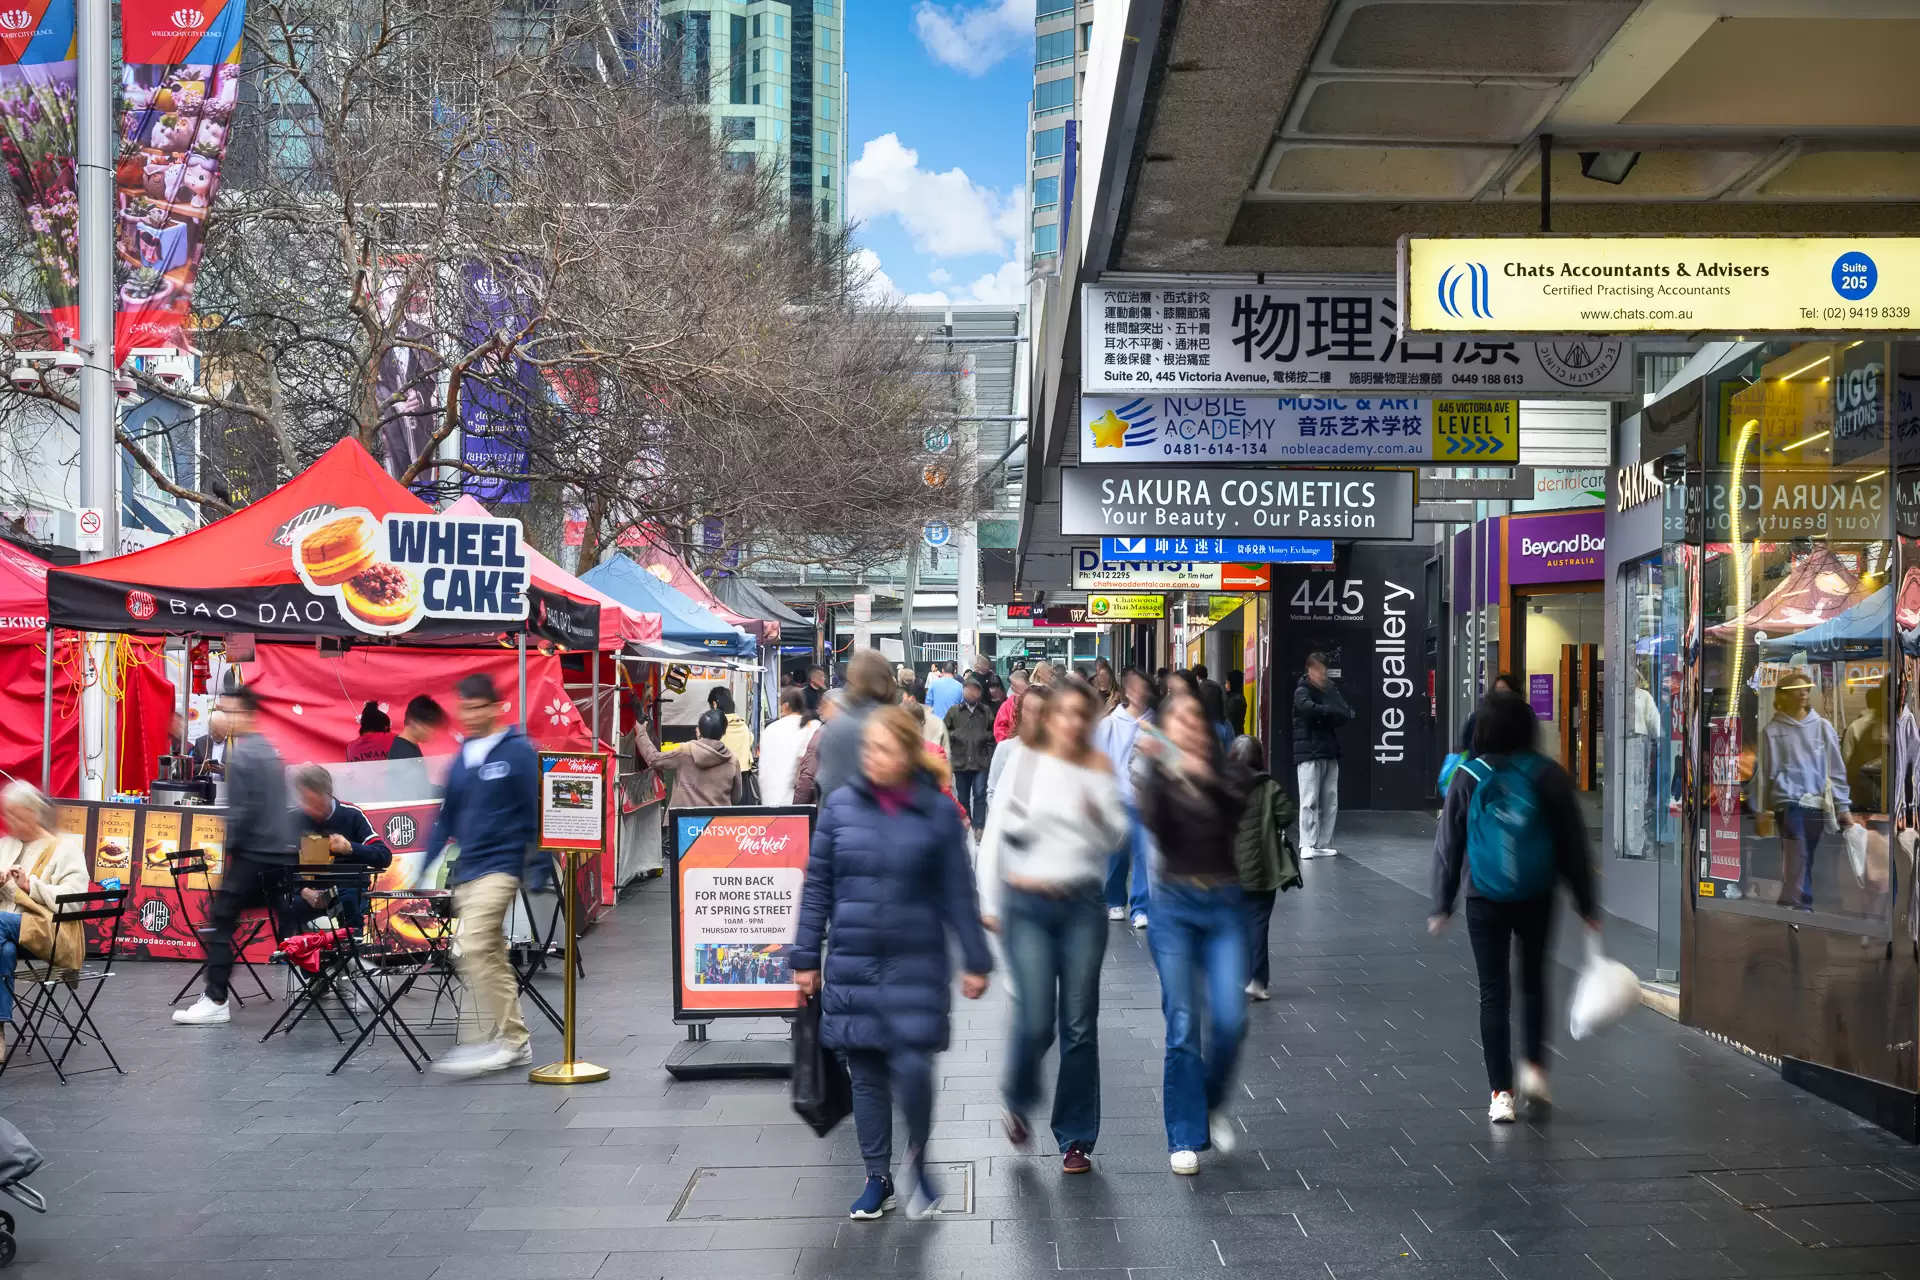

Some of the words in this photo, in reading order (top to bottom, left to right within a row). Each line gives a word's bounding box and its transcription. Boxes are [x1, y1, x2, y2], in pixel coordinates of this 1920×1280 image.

[1503, 262, 1555, 277] Chats
[1560, 262, 1670, 277] Accountants
[1676, 262, 1691, 277] &
[1696, 262, 1770, 277] Advisers
[1841, 262, 1868, 273] Suite
[1841, 276, 1868, 290] 205
[1543, 284, 1593, 296] Certified
[1597, 284, 1654, 298] Practising
[1657, 284, 1731, 296] Accountants
[1580, 307, 1693, 320] www.chats.com.au
[1799, 307, 1819, 319] Tel:
[1822, 307, 1846, 321] (02)
[1849, 307, 1879, 319] 9419
[1881, 306, 1911, 318] 8339
[1104, 370, 1133, 381] Suite
[1136, 371, 1153, 383] 20,
[1155, 371, 1176, 381] 445
[1178, 371, 1222, 382] Victoria
[1224, 372, 1270, 384] Avenue,
[1273, 371, 1332, 384] 電梯按二樓
[1452, 374, 1478, 384] 0449
[1482, 374, 1501, 384] 188
[1504, 374, 1524, 385] 613
[1836, 362, 1877, 412] UGG
[1165, 397, 1247, 417] NOBLE
[1278, 398, 1347, 411] MUSIC
[1356, 398, 1372, 411] &
[1379, 398, 1419, 410] ART
[1438, 402, 1454, 413] 445
[1455, 402, 1492, 413] VICTORIA
[1494, 402, 1509, 413] AVE
[1165, 418, 1276, 440] ACADEMY
[1298, 416, 1422, 437] 音乐艺术学校
[1438, 416, 1493, 435] LEVEL
[1504, 416, 1510, 434] 1
[1164, 443, 1268, 455] 0481-614-134
[1281, 443, 1423, 456] nobleacademy.com.au
[1101, 478, 1211, 506] SAKURA
[1221, 480, 1376, 508] COSMETICS
[1101, 507, 1147, 525] Your
[1156, 508, 1227, 530] Beauty
[1253, 509, 1290, 527] Our
[1299, 510, 1376, 528] Passion
[388, 519, 525, 568] WHEEL
[1268, 545, 1288, 556] Money
[1290, 545, 1321, 556] Exchange
[1522, 534, 1579, 558] Beyond
[1546, 557, 1595, 567] AUSTRALIA
[1079, 571, 1091, 579] Ph:
[1092, 571, 1111, 579] 9412
[1112, 571, 1130, 579] 2295
[423, 567, 525, 615] CAKE
[1093, 581, 1200, 589] chatswooddentalcare.com.au
[1290, 579, 1364, 614] 445
[169, 598, 236, 618] BAO
[258, 600, 325, 623] DAO
[1008, 606, 1032, 616] UFC
[1375, 580, 1415, 698] gallery
[1374, 707, 1405, 764] the
[568, 762, 599, 773] Market
[101, 820, 132, 828] CHOCOLATE
[687, 825, 767, 837] CHATSWOOD
[735, 834, 791, 855] Market
[713, 876, 743, 886] TURN
[745, 876, 775, 886] BACK
[695, 891, 717, 900] FOR
[719, 891, 751, 900] MORE
[753, 890, 792, 900] STALLS
[695, 905, 708, 915] AT
[710, 905, 750, 915] SPRING
[753, 905, 792, 915] STREET
